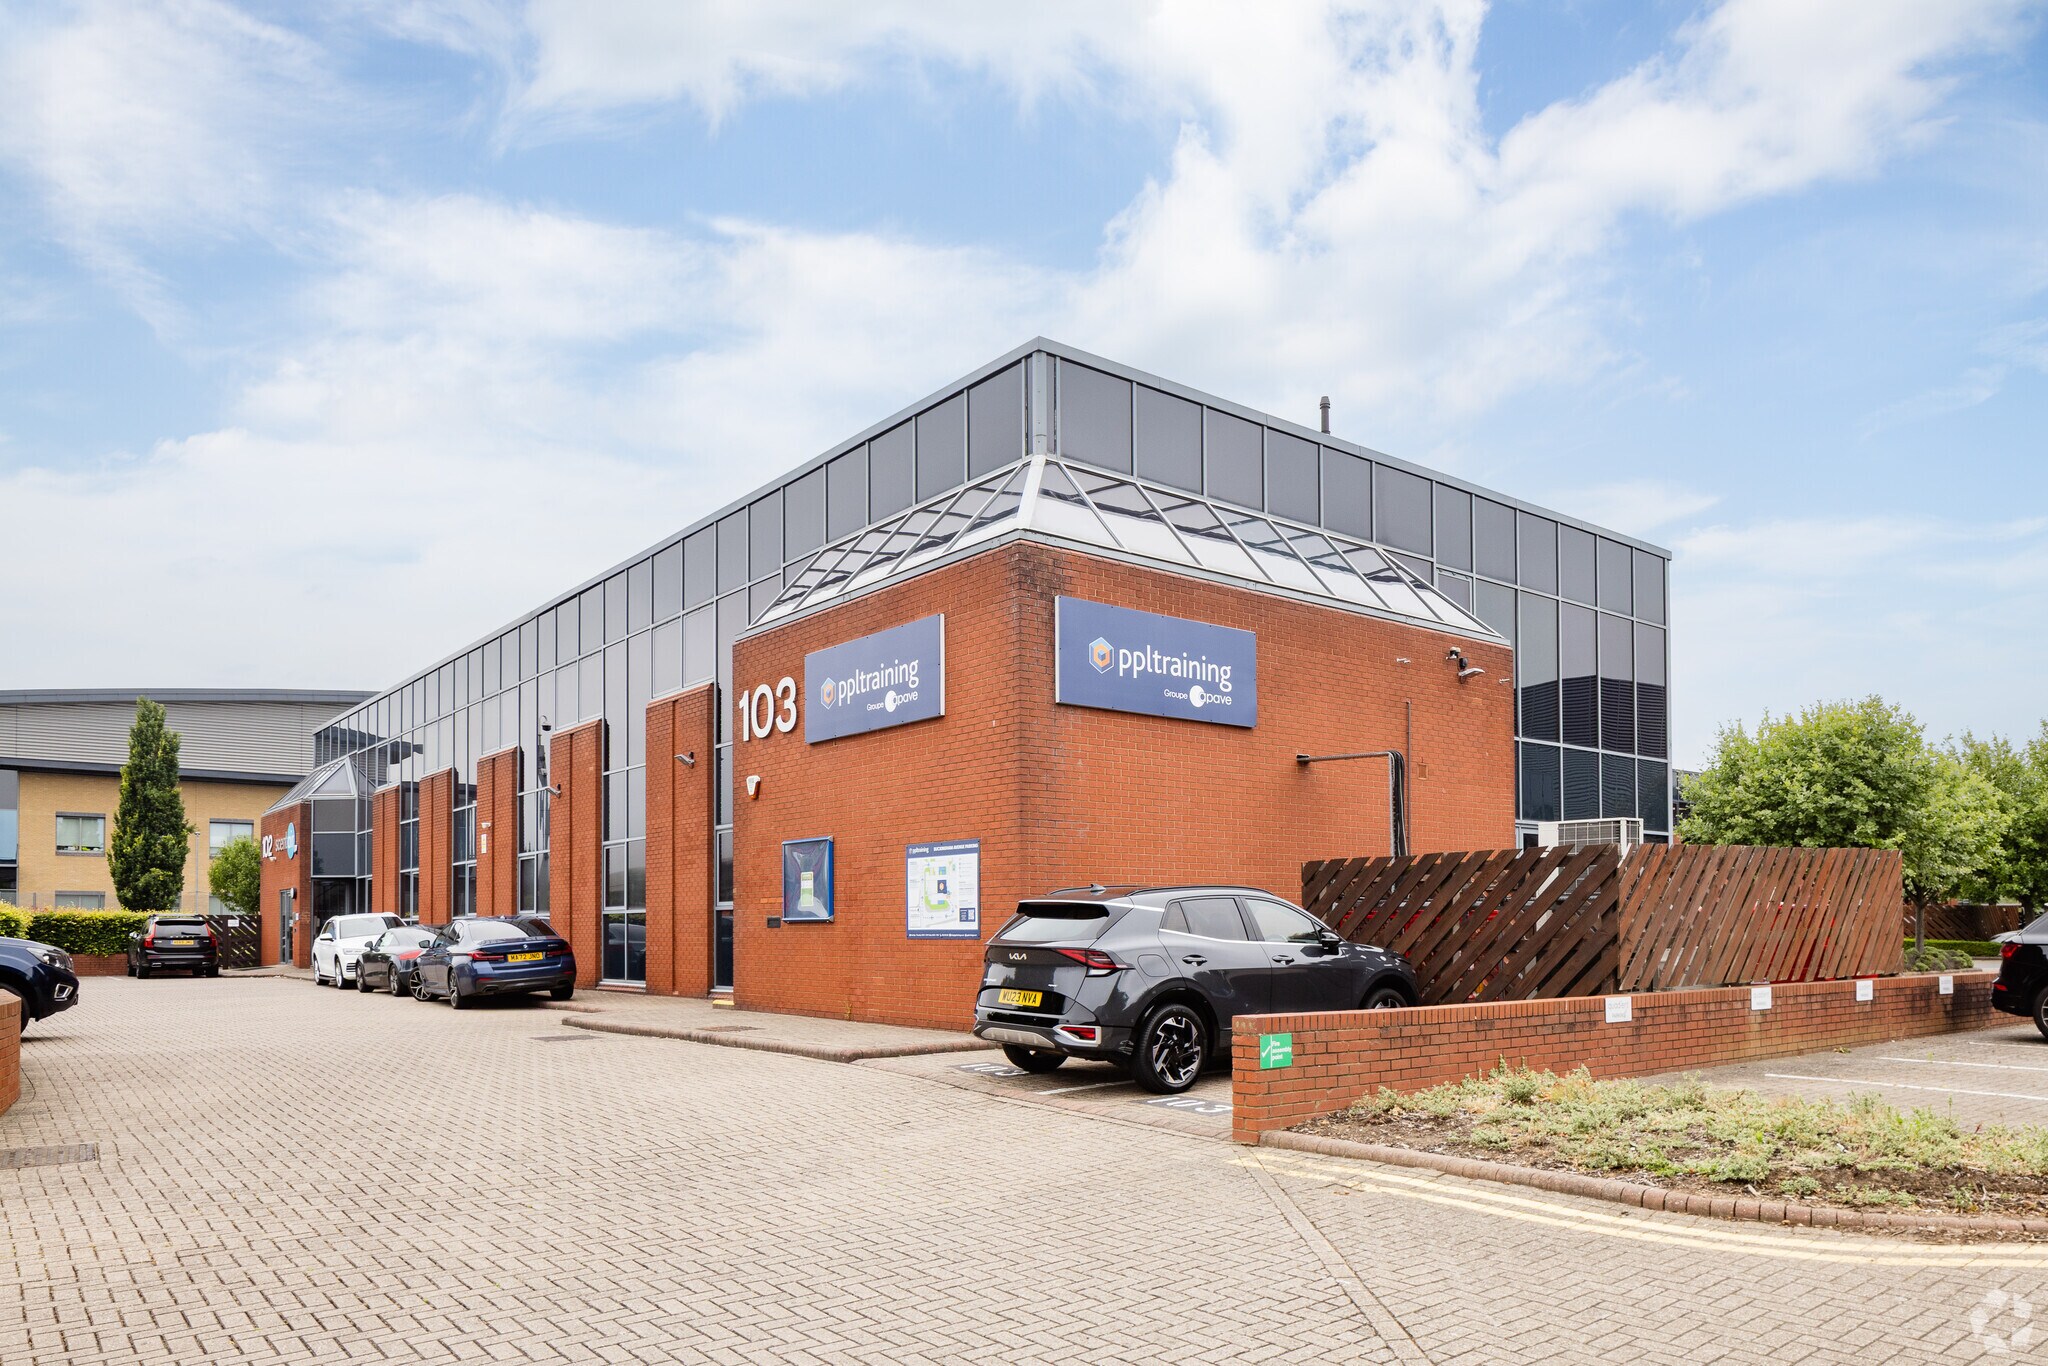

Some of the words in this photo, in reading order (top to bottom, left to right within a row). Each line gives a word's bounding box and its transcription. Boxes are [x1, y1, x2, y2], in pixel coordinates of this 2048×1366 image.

[1119, 645, 1232, 692] ppltraining
[839, 659, 919, 706] ppltraining
[866, 701, 884, 712] Groupe
[893, 690, 918, 706] apave
[1163, 688, 1188, 700] Groupe
[1199, 691, 1232, 705] apave
[738, 676, 798, 742] 103
[262, 834, 273, 858] 102
[1009, 952, 1027, 960] KIA
[1002, 990, 1021, 1002] WU23
[1022, 992, 1037, 1004] NVA
[1147, 1097, 1233, 1113] 103
